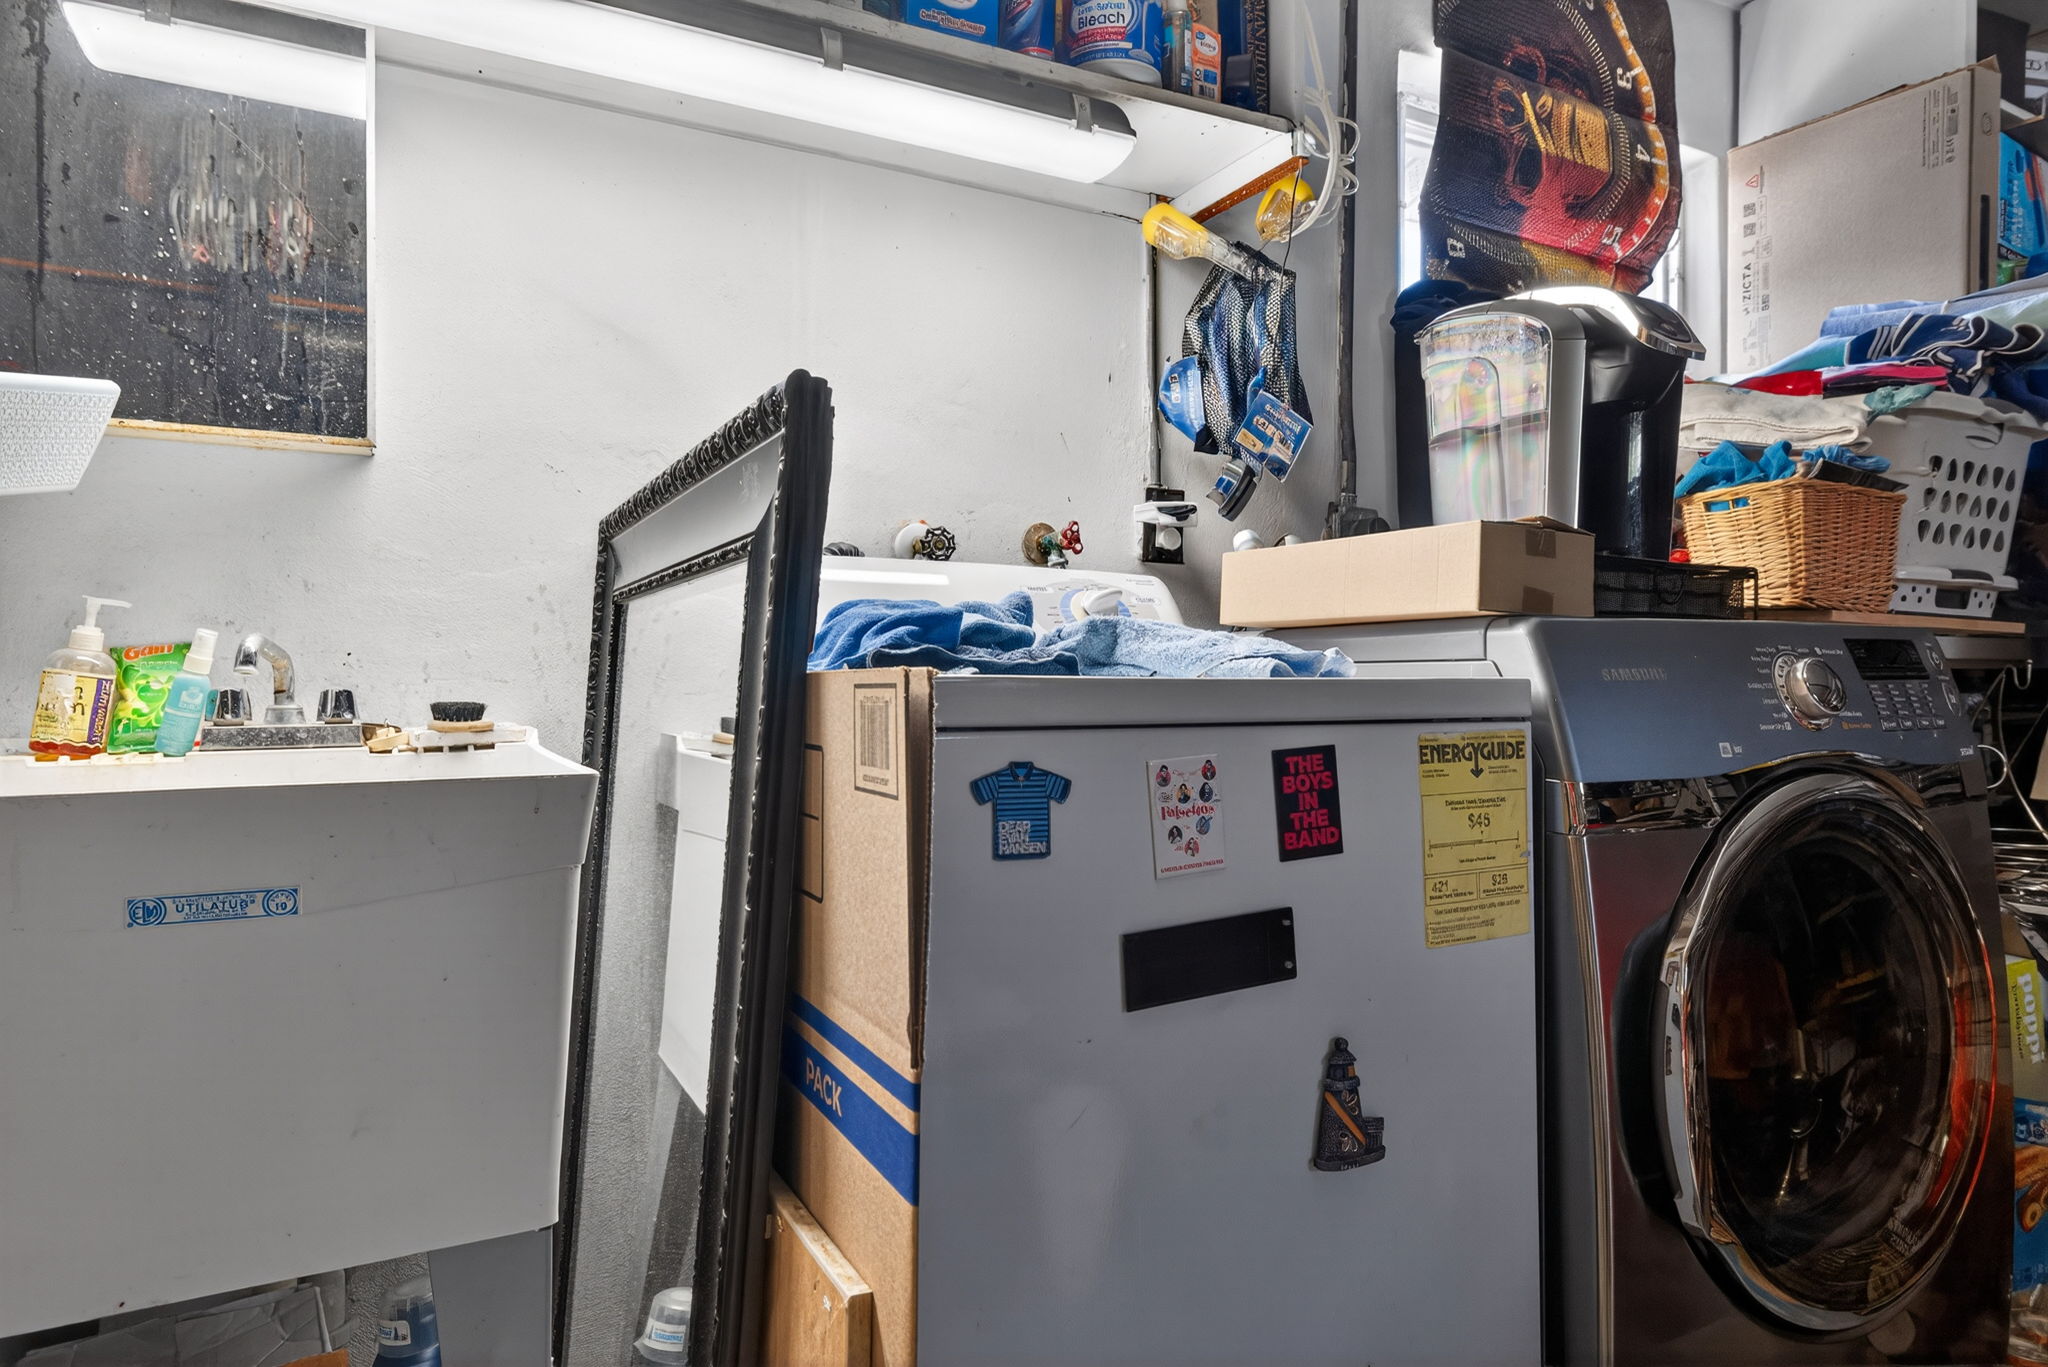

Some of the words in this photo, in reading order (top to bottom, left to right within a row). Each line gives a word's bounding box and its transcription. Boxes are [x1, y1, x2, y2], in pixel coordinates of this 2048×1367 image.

[1078, 12, 1126, 29] Bleach
[124, 644, 173, 661] Gain
[1419, 741, 1525, 764] ENERGYGUIDE
[1285, 753, 1325, 774] THE
[1282, 771, 1333, 793] BOYS
[1298, 791, 1319, 810] IN
[1290, 809, 1329, 830] THE
[1284, 826, 1340, 850] BAND
[2016, 973, 2045, 1065] poppi
[805, 1056, 843, 1118] PACK
